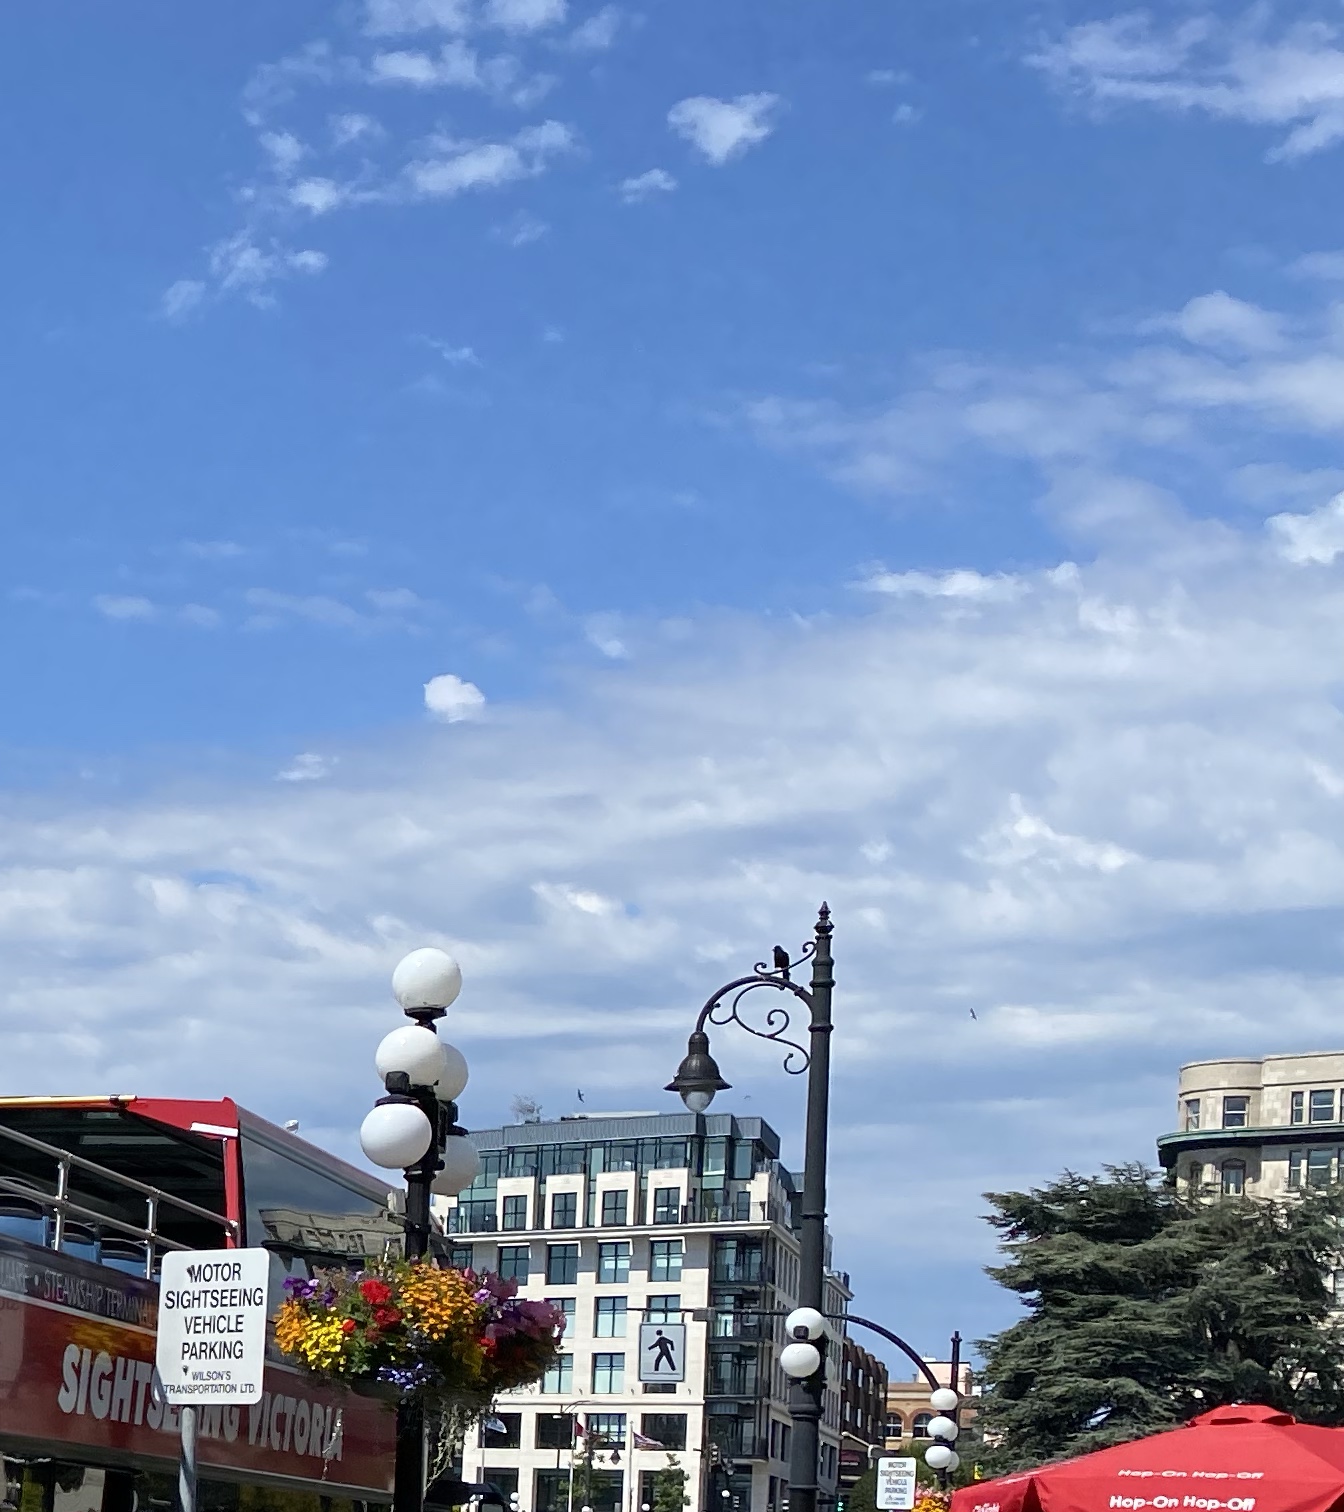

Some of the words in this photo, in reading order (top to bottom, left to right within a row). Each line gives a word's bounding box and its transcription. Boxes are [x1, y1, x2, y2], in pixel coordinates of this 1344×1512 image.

[189, 1262, 242, 1283] MOTOR
[44, 1268, 103, 1312] STEAMSHIP
[164, 1287, 264, 1309] SIGHTSEEING
[184, 1314, 244, 1334] VEHICLE
[181, 1340, 244, 1360] PARKING
[191, 1371, 231, 1381] WILSON'S
[164, 1384, 237, 1394] TRANSPORTATION
[240, 1383, 257, 1394] LTD.
[248, 1391, 345, 1461] VICTORIA
[1118, 1469, 1188, 1479] Hop-On
[1192, 1470, 1265, 1479] Hop-Off
[1109, 1495, 1179, 1511] Hop-On
[1182, 1496, 1256, 1512] Hop-Off
